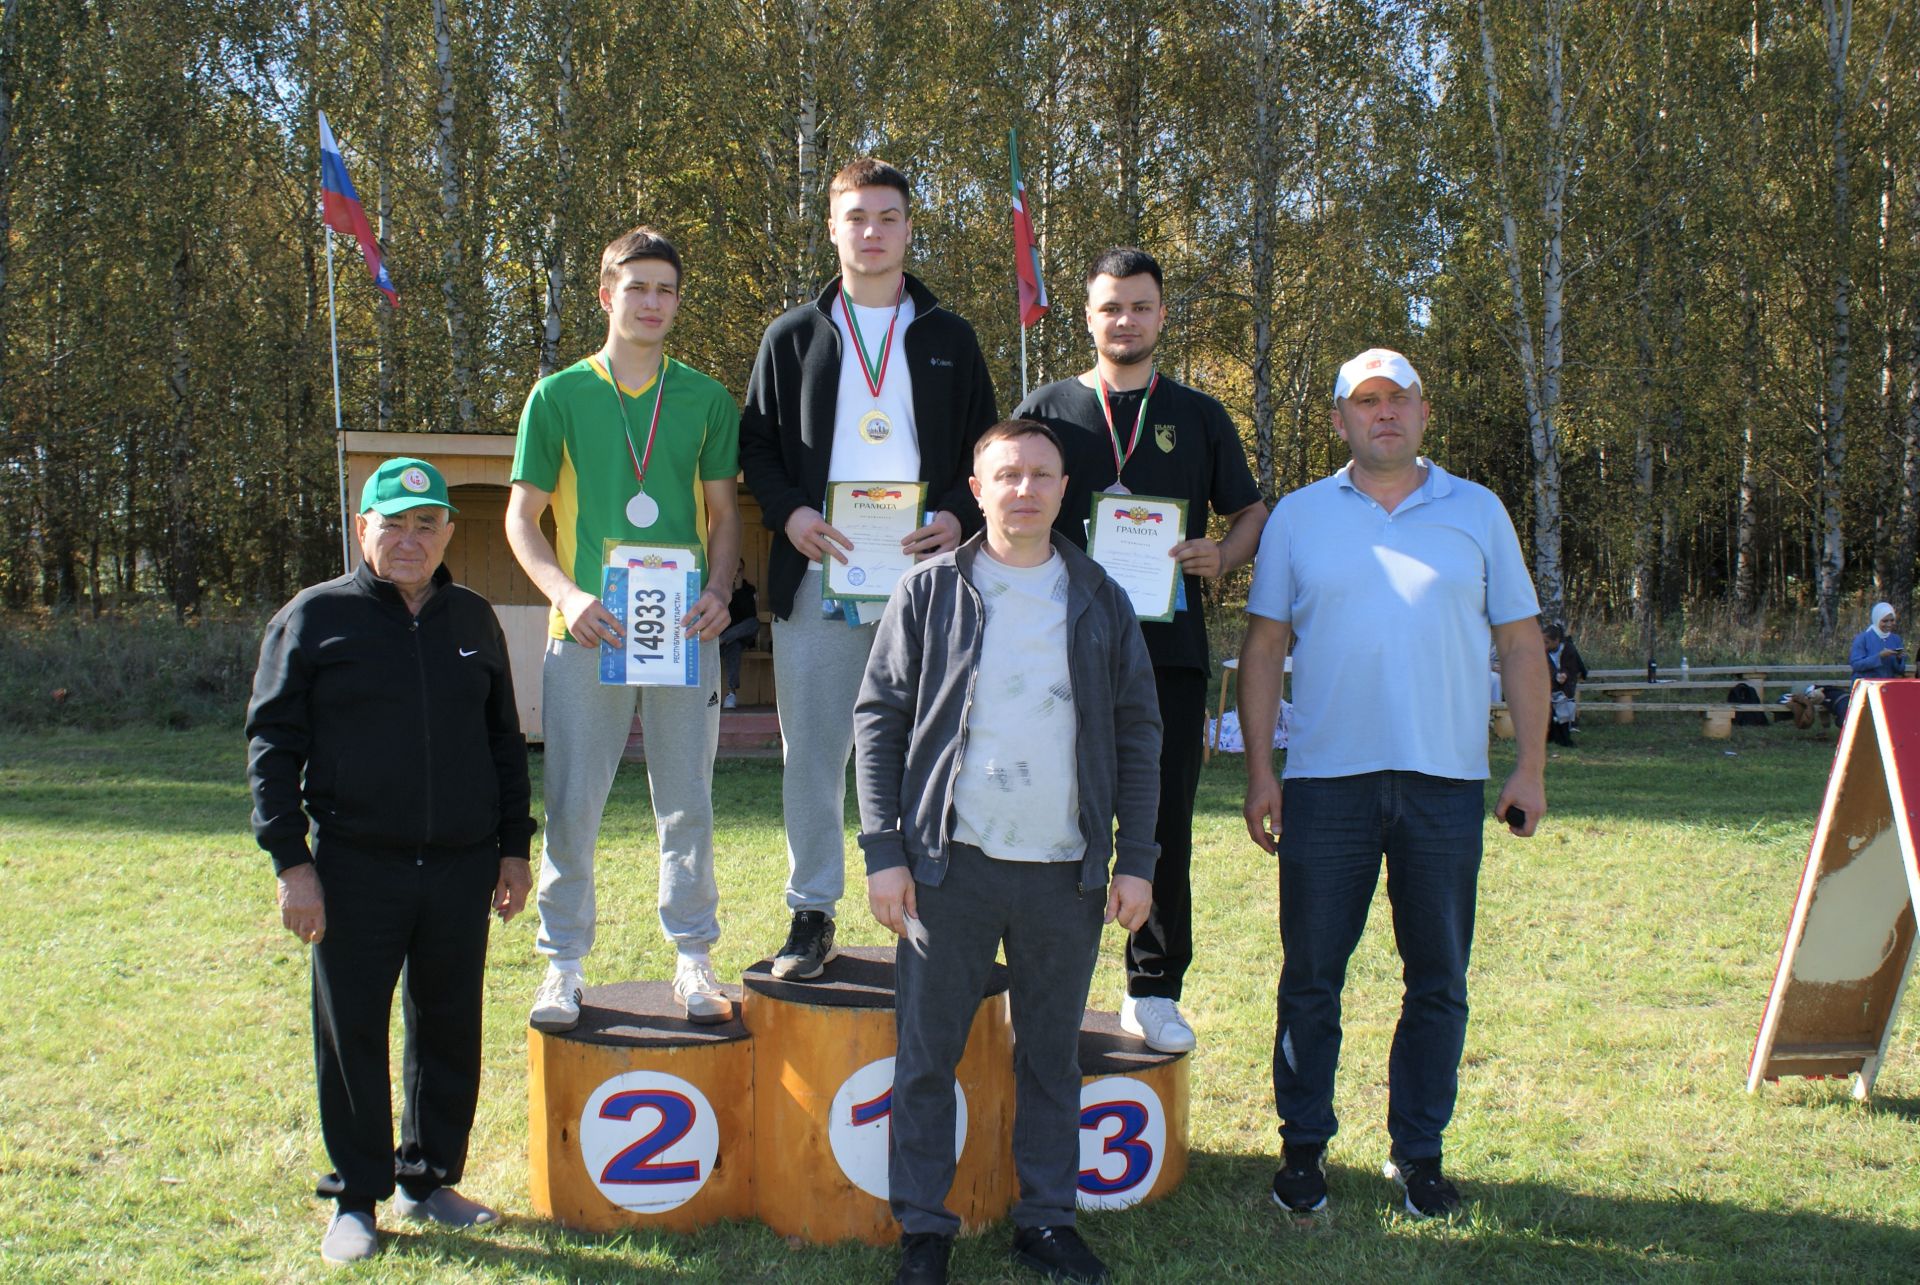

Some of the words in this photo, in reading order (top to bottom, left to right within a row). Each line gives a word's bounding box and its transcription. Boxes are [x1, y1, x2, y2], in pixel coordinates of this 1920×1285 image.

[854, 502, 897, 510] ГРАМОТА
[1116, 525, 1158, 536] ГРАМОТА
[633, 589, 666, 664] 14933
[673, 626, 681, 664] РЕСПУБЛИКА
[599, 1089, 700, 1184] 2
[1077, 1100, 1153, 1195] 3
